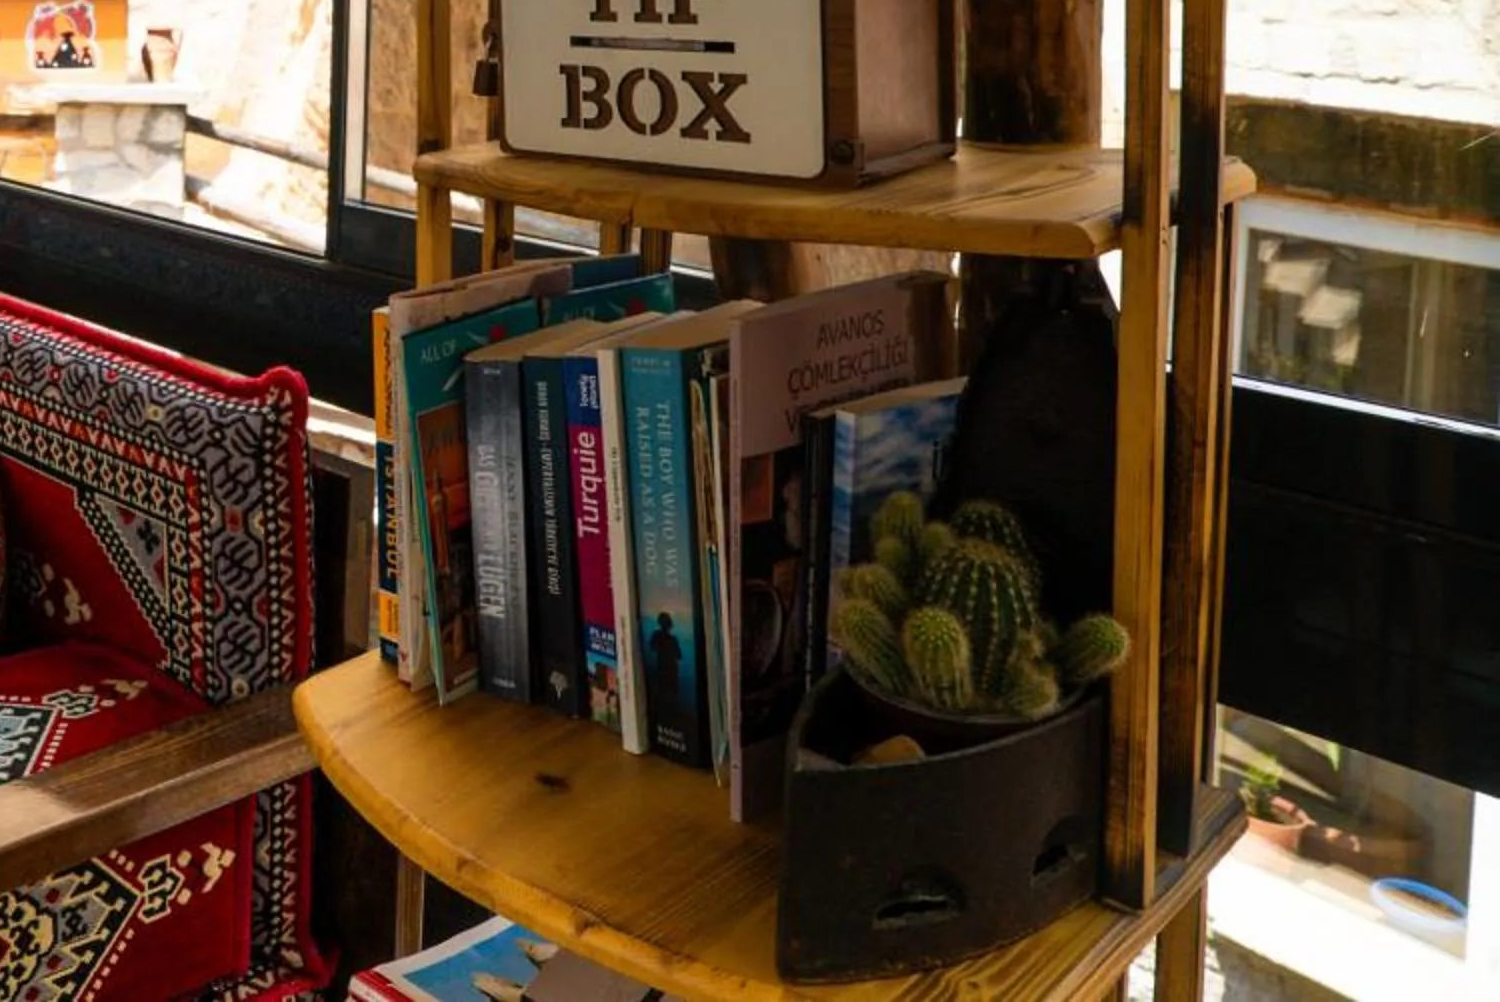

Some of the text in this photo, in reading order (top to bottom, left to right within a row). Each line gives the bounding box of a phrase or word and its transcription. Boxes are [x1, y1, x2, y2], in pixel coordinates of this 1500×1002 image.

[559, 63, 751, 144] BOX
[817, 309, 885, 350] AVANOS
[574, 431, 602, 538] Turquie
[635, 406, 658, 575] RAISED AS A DOG
[656, 401, 678, 587] THE BOY WHO WAS
